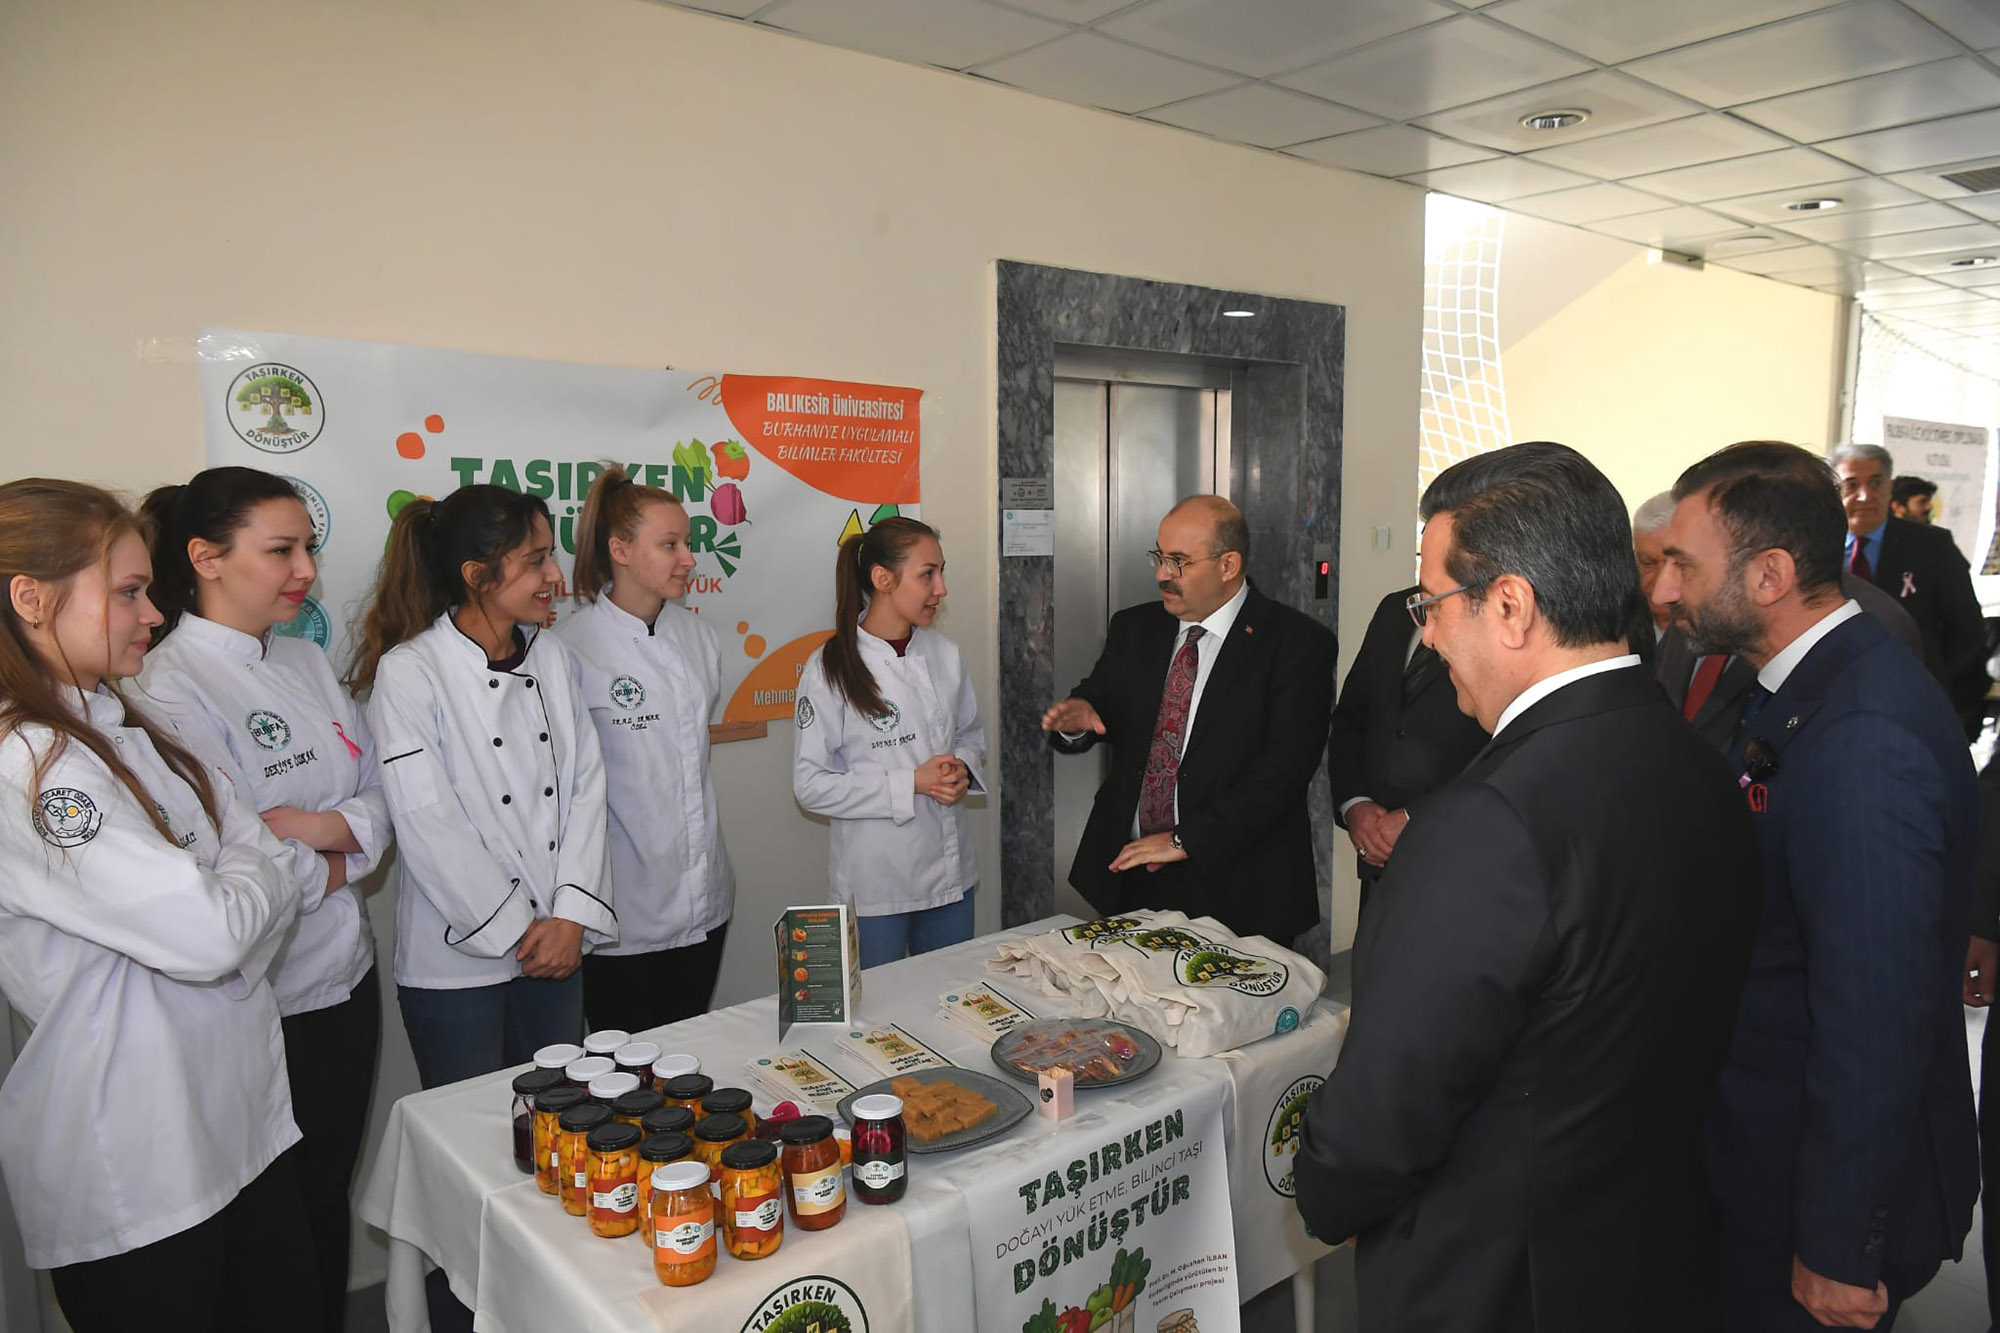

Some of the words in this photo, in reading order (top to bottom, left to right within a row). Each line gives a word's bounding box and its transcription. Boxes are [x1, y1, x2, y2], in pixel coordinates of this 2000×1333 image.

[766, 391, 829, 416] BALIKESİR
[832, 393, 905, 421] ÜNİVERSİTESİ
[246, 429, 310, 448] DÖNÜŞTÜR
[762, 420, 839, 440] BURHANİYE
[840, 426, 915, 443] UYGULAMALI
[777, 443, 836, 461] BİLİMLER
[838, 447, 903, 464] FAKÜLTESİ
[1321, 562, 1328, 575] 0
[1018, 1108, 1185, 1216] TAŞIRKEN
[996, 1218, 1053, 1259] DOĞAYI
[1056, 1201, 1086, 1227] YÜK
[1089, 1181, 1128, 1213] ETME,
[1131, 1157, 1176, 1189] BİLİNCİ
[1178, 1140, 1203, 1164] TAŞI
[1013, 1174, 1191, 1294] DÖNÜŞTÜR
[1206, 1253, 1228, 1262] İLBAN
[1184, 1266, 1217, 1282] yürütülen
[1218, 1265, 1230, 1273] bir
[1199, 1276, 1225, 1289] projesi
